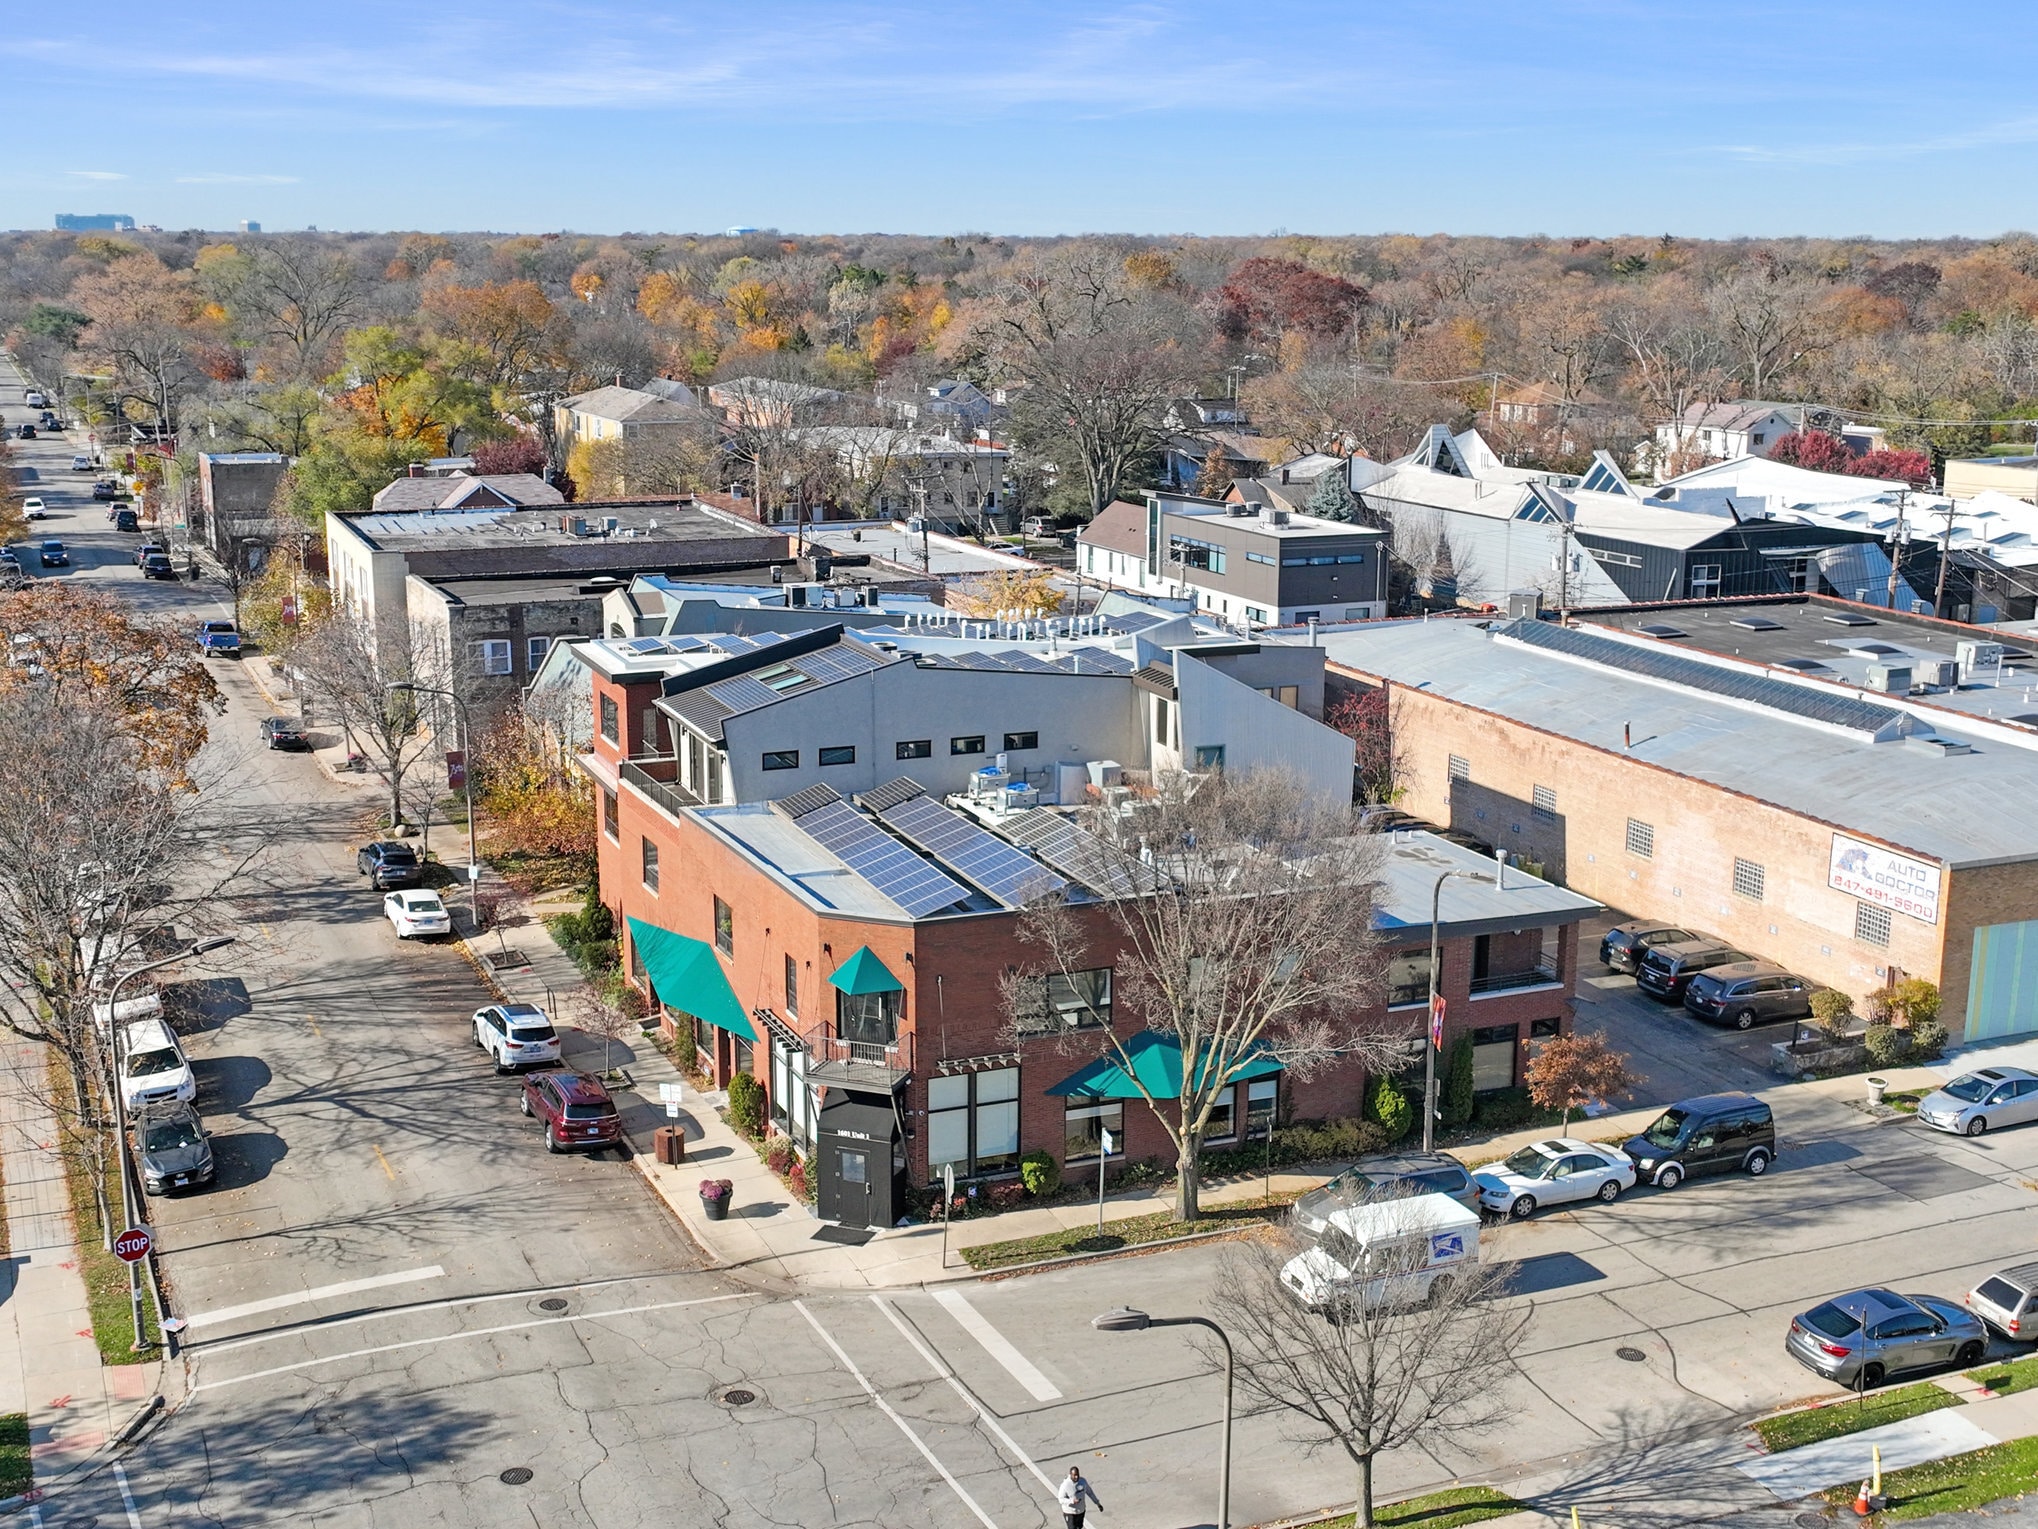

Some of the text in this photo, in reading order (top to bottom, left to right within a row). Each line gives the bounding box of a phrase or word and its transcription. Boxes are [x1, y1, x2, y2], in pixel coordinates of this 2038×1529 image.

[1887, 860, 1926, 882] AUTO
[1875, 872, 1936, 902] DOCTOR
[117, 1237, 148, 1254] STOP
